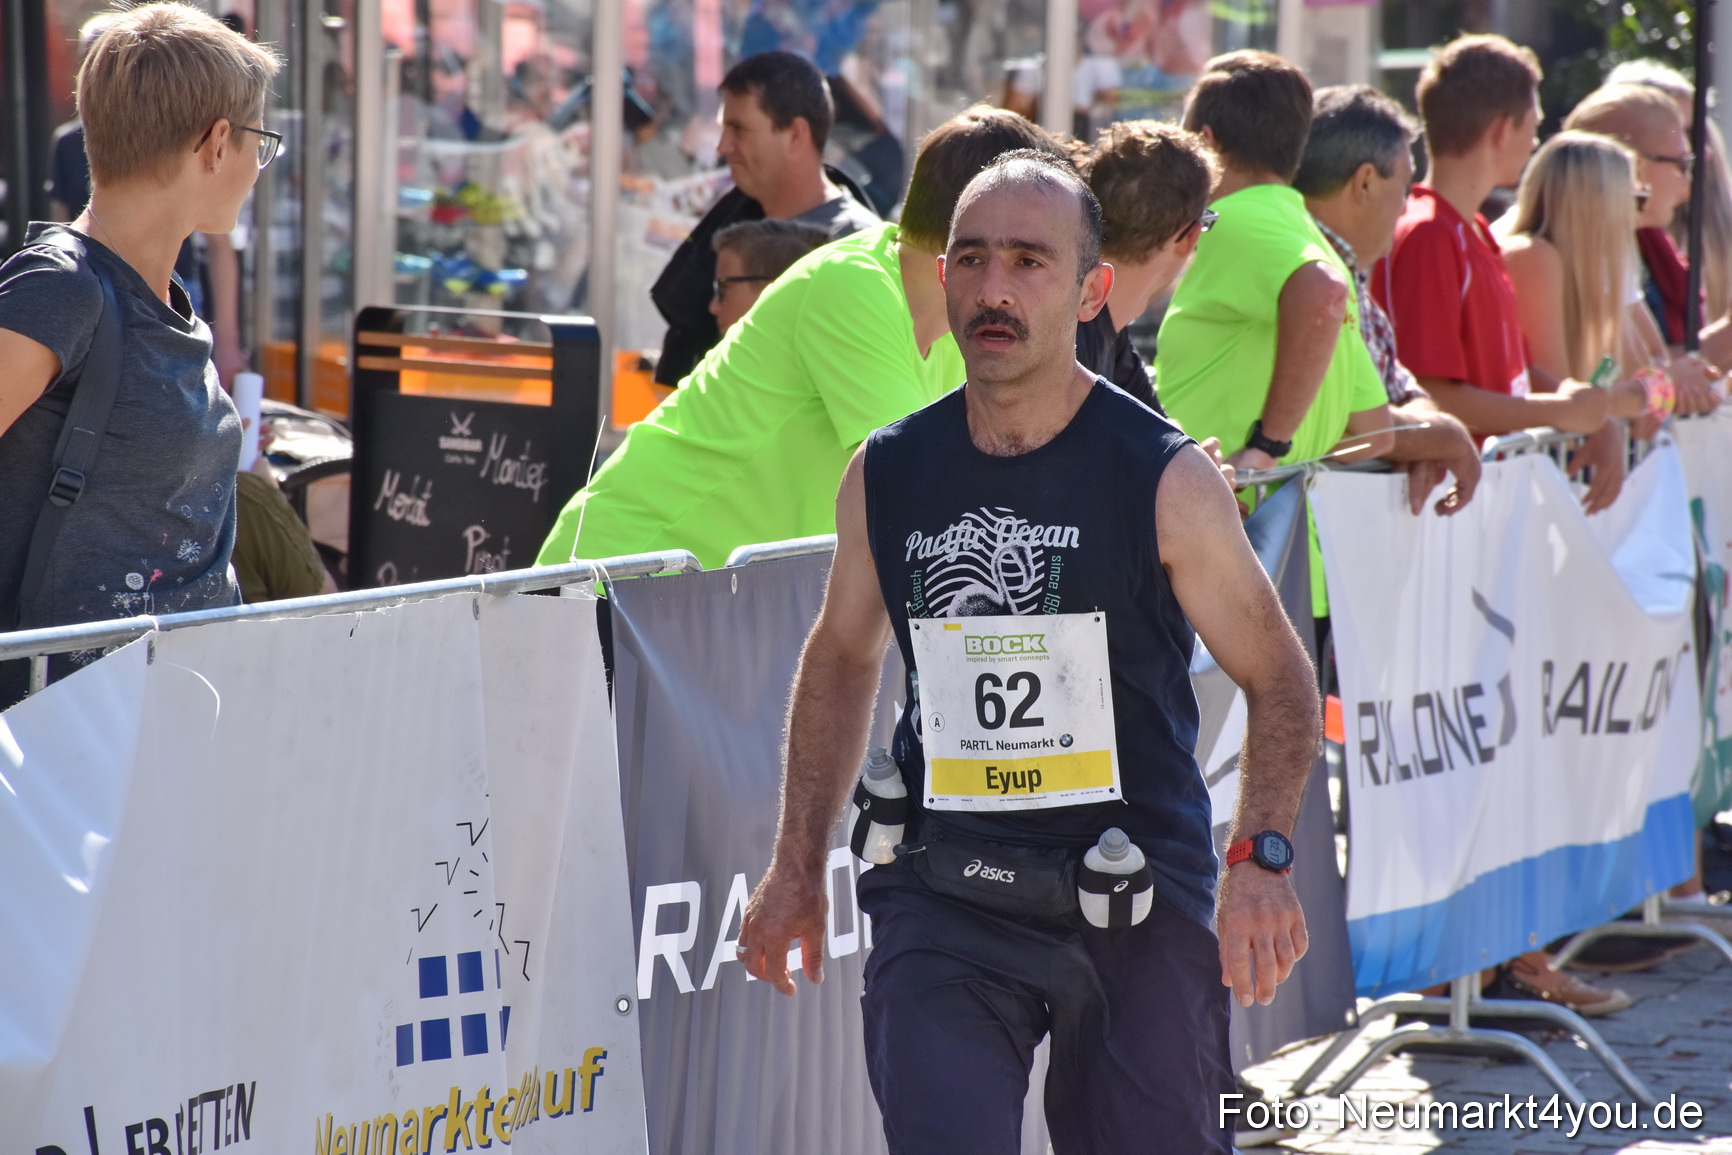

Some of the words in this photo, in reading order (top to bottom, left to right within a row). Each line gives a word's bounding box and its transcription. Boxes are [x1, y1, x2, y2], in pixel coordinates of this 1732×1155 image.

[905, 519, 987, 563] Pacific
[993, 515, 1080, 549] Ocean
[1048, 555, 1064, 589] since
[910, 569, 924, 612] Beach
[964, 634, 1048, 655] BOCK
[974, 671, 1045, 730] 62
[960, 740, 993, 750] PARTL
[996, 738, 1055, 750] Neumarkt
[985, 766, 1042, 794] Eyup
[979, 865, 1016, 884] asics
